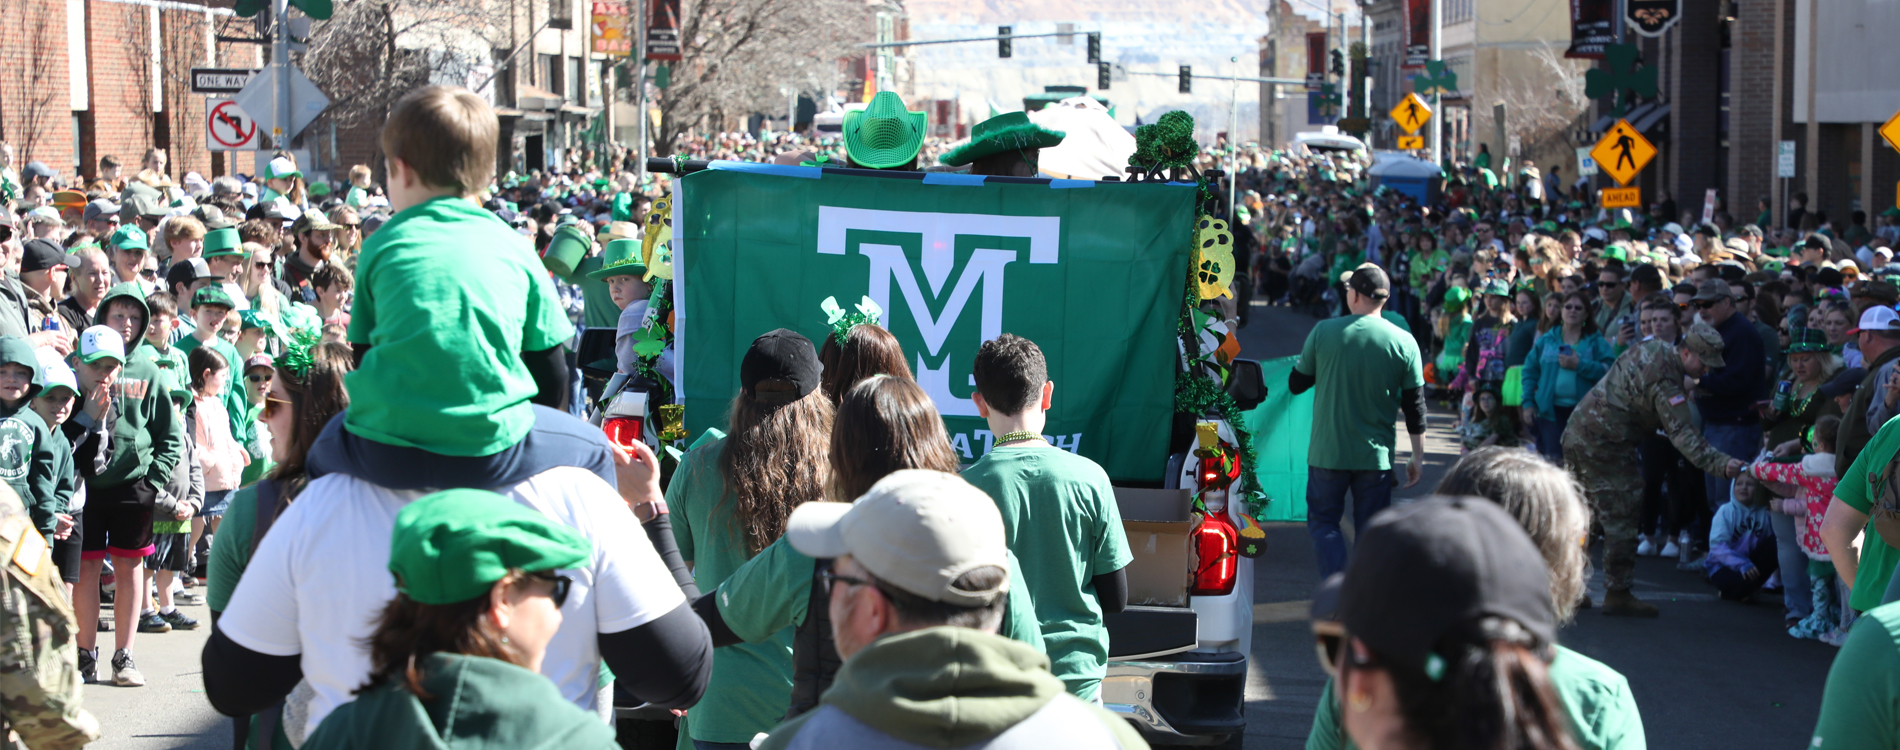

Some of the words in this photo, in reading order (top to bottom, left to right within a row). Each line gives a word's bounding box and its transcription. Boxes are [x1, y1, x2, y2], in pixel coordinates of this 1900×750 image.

[199, 75, 222, 86] ONE
[225, 75, 248, 87] WAY
[1607, 191, 1636, 203] AHEAD
[19, 424, 34, 445] TECH
